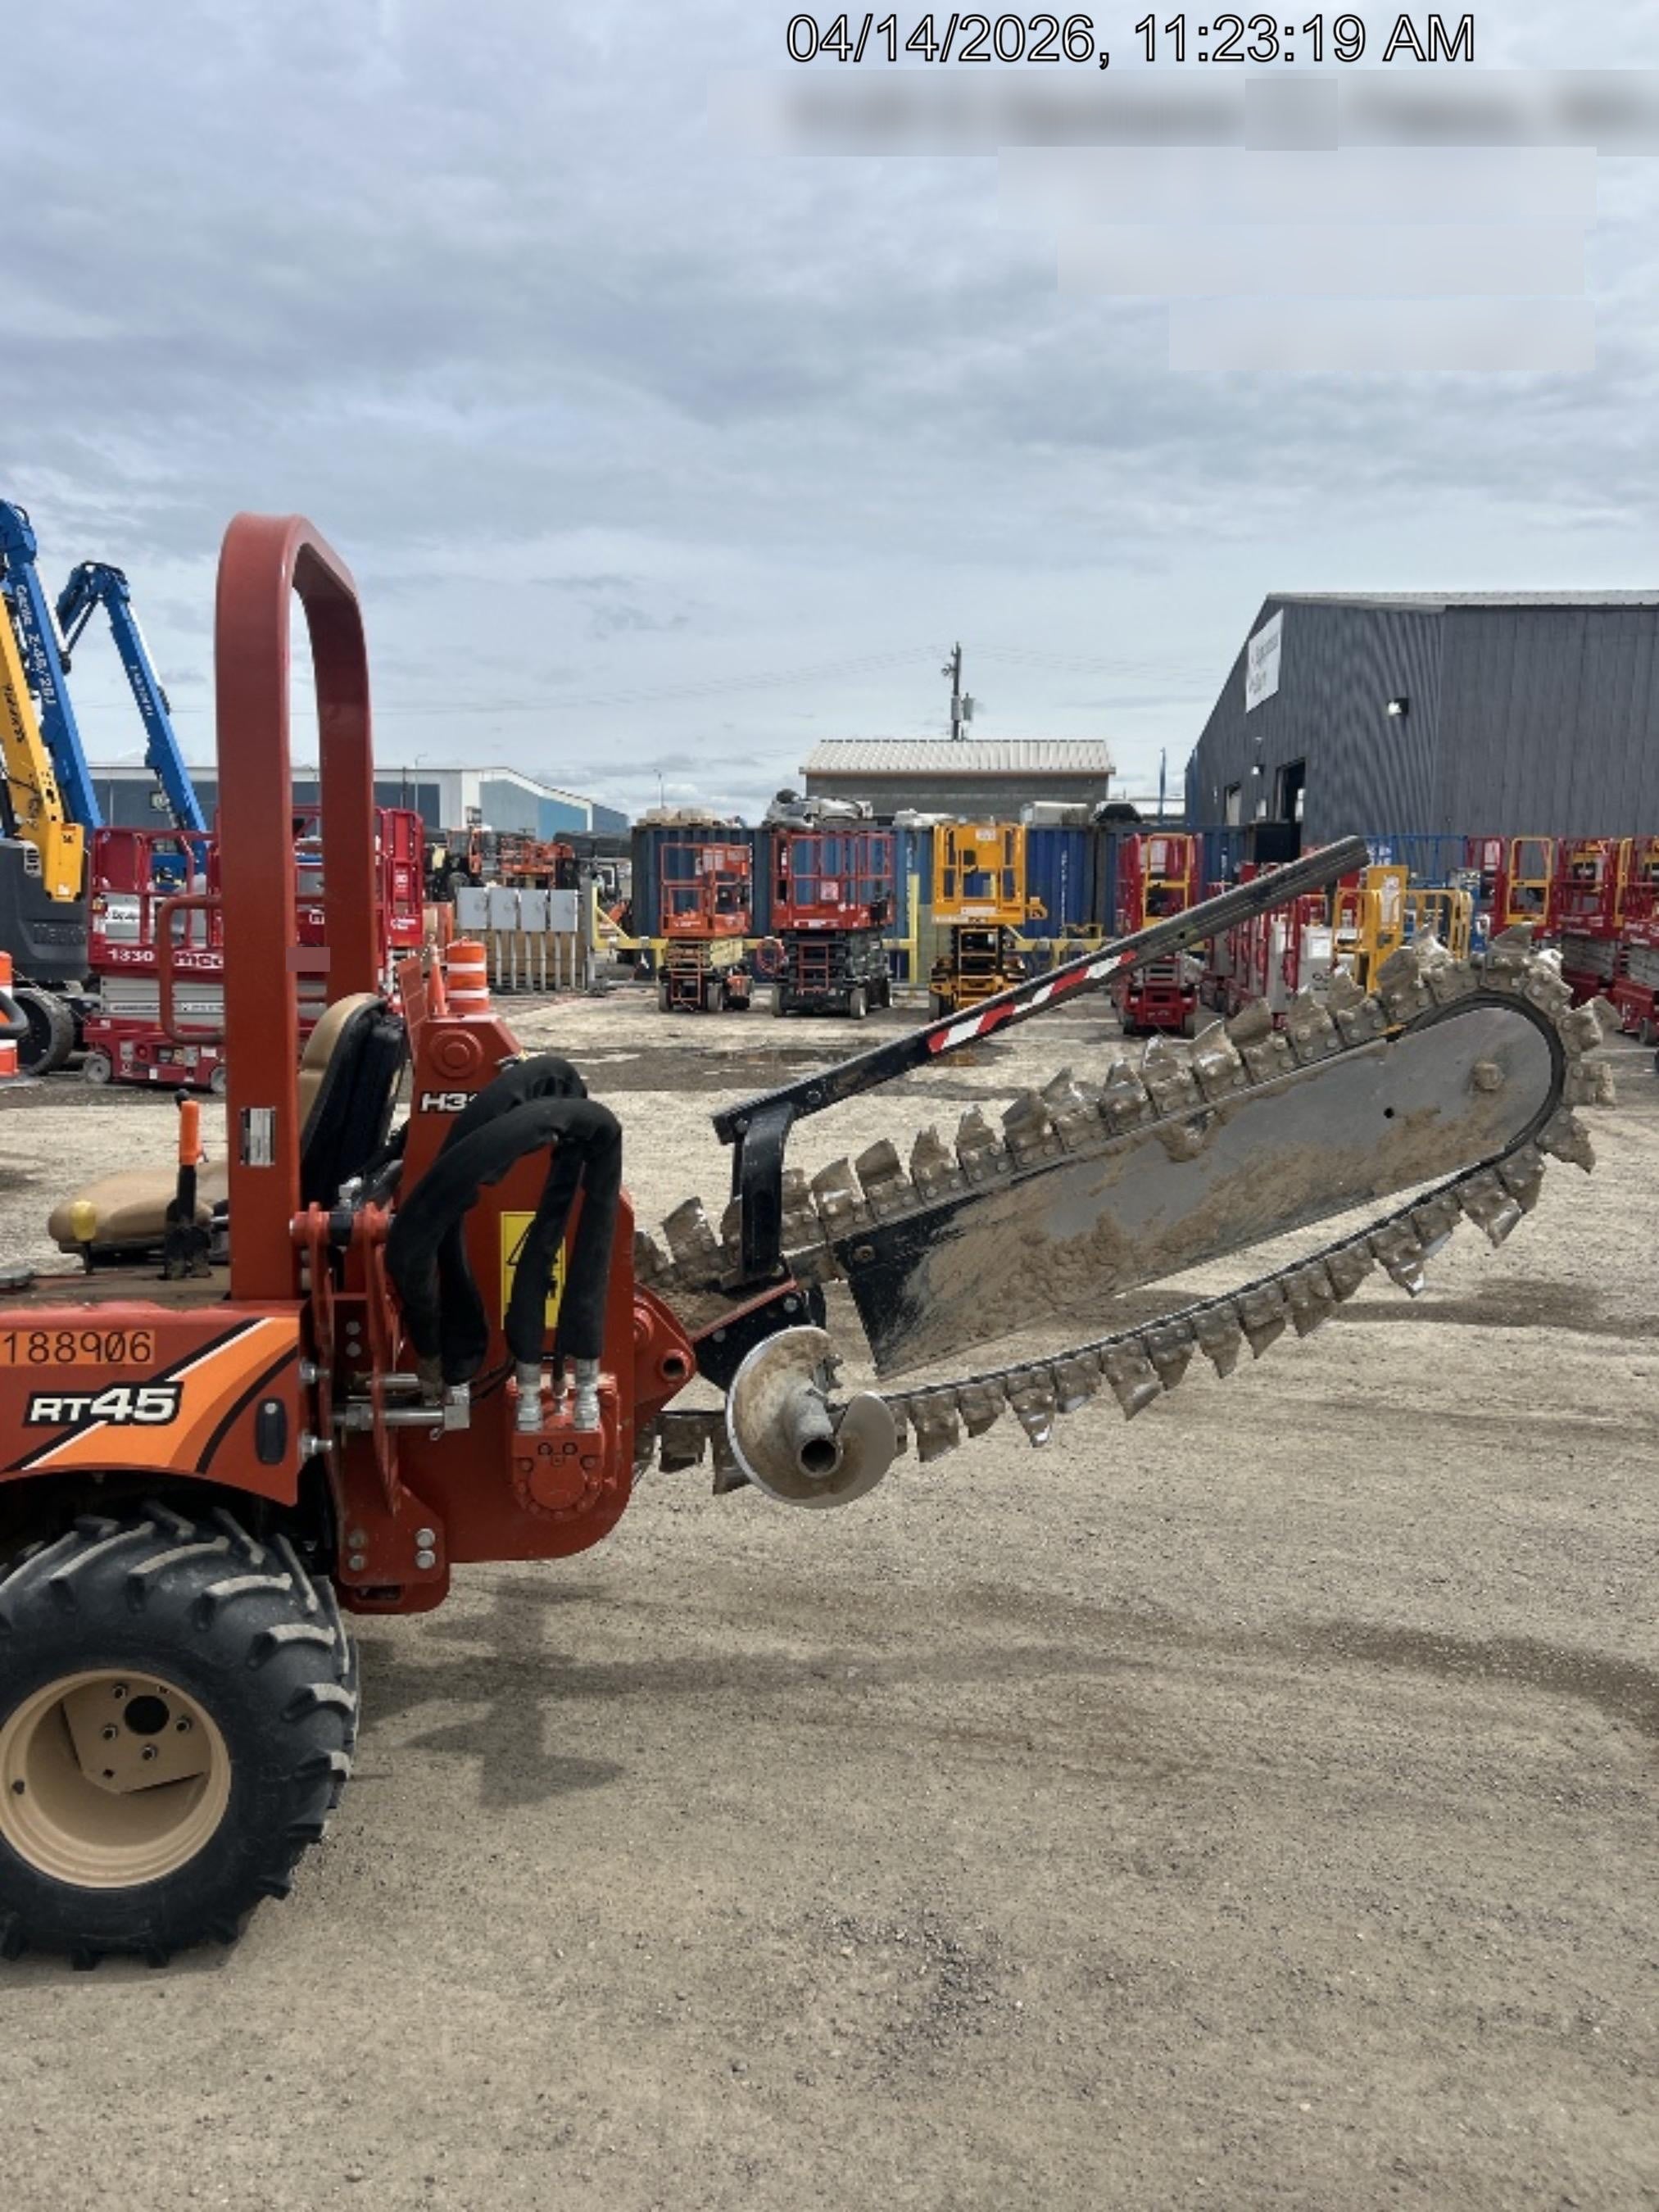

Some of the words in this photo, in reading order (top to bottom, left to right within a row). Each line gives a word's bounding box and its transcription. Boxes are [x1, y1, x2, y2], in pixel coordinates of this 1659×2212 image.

[420, 1091, 478, 1112] H3
[3, 1331, 152, 1364] 188906
[29, 1387, 178, 1422] RT45
